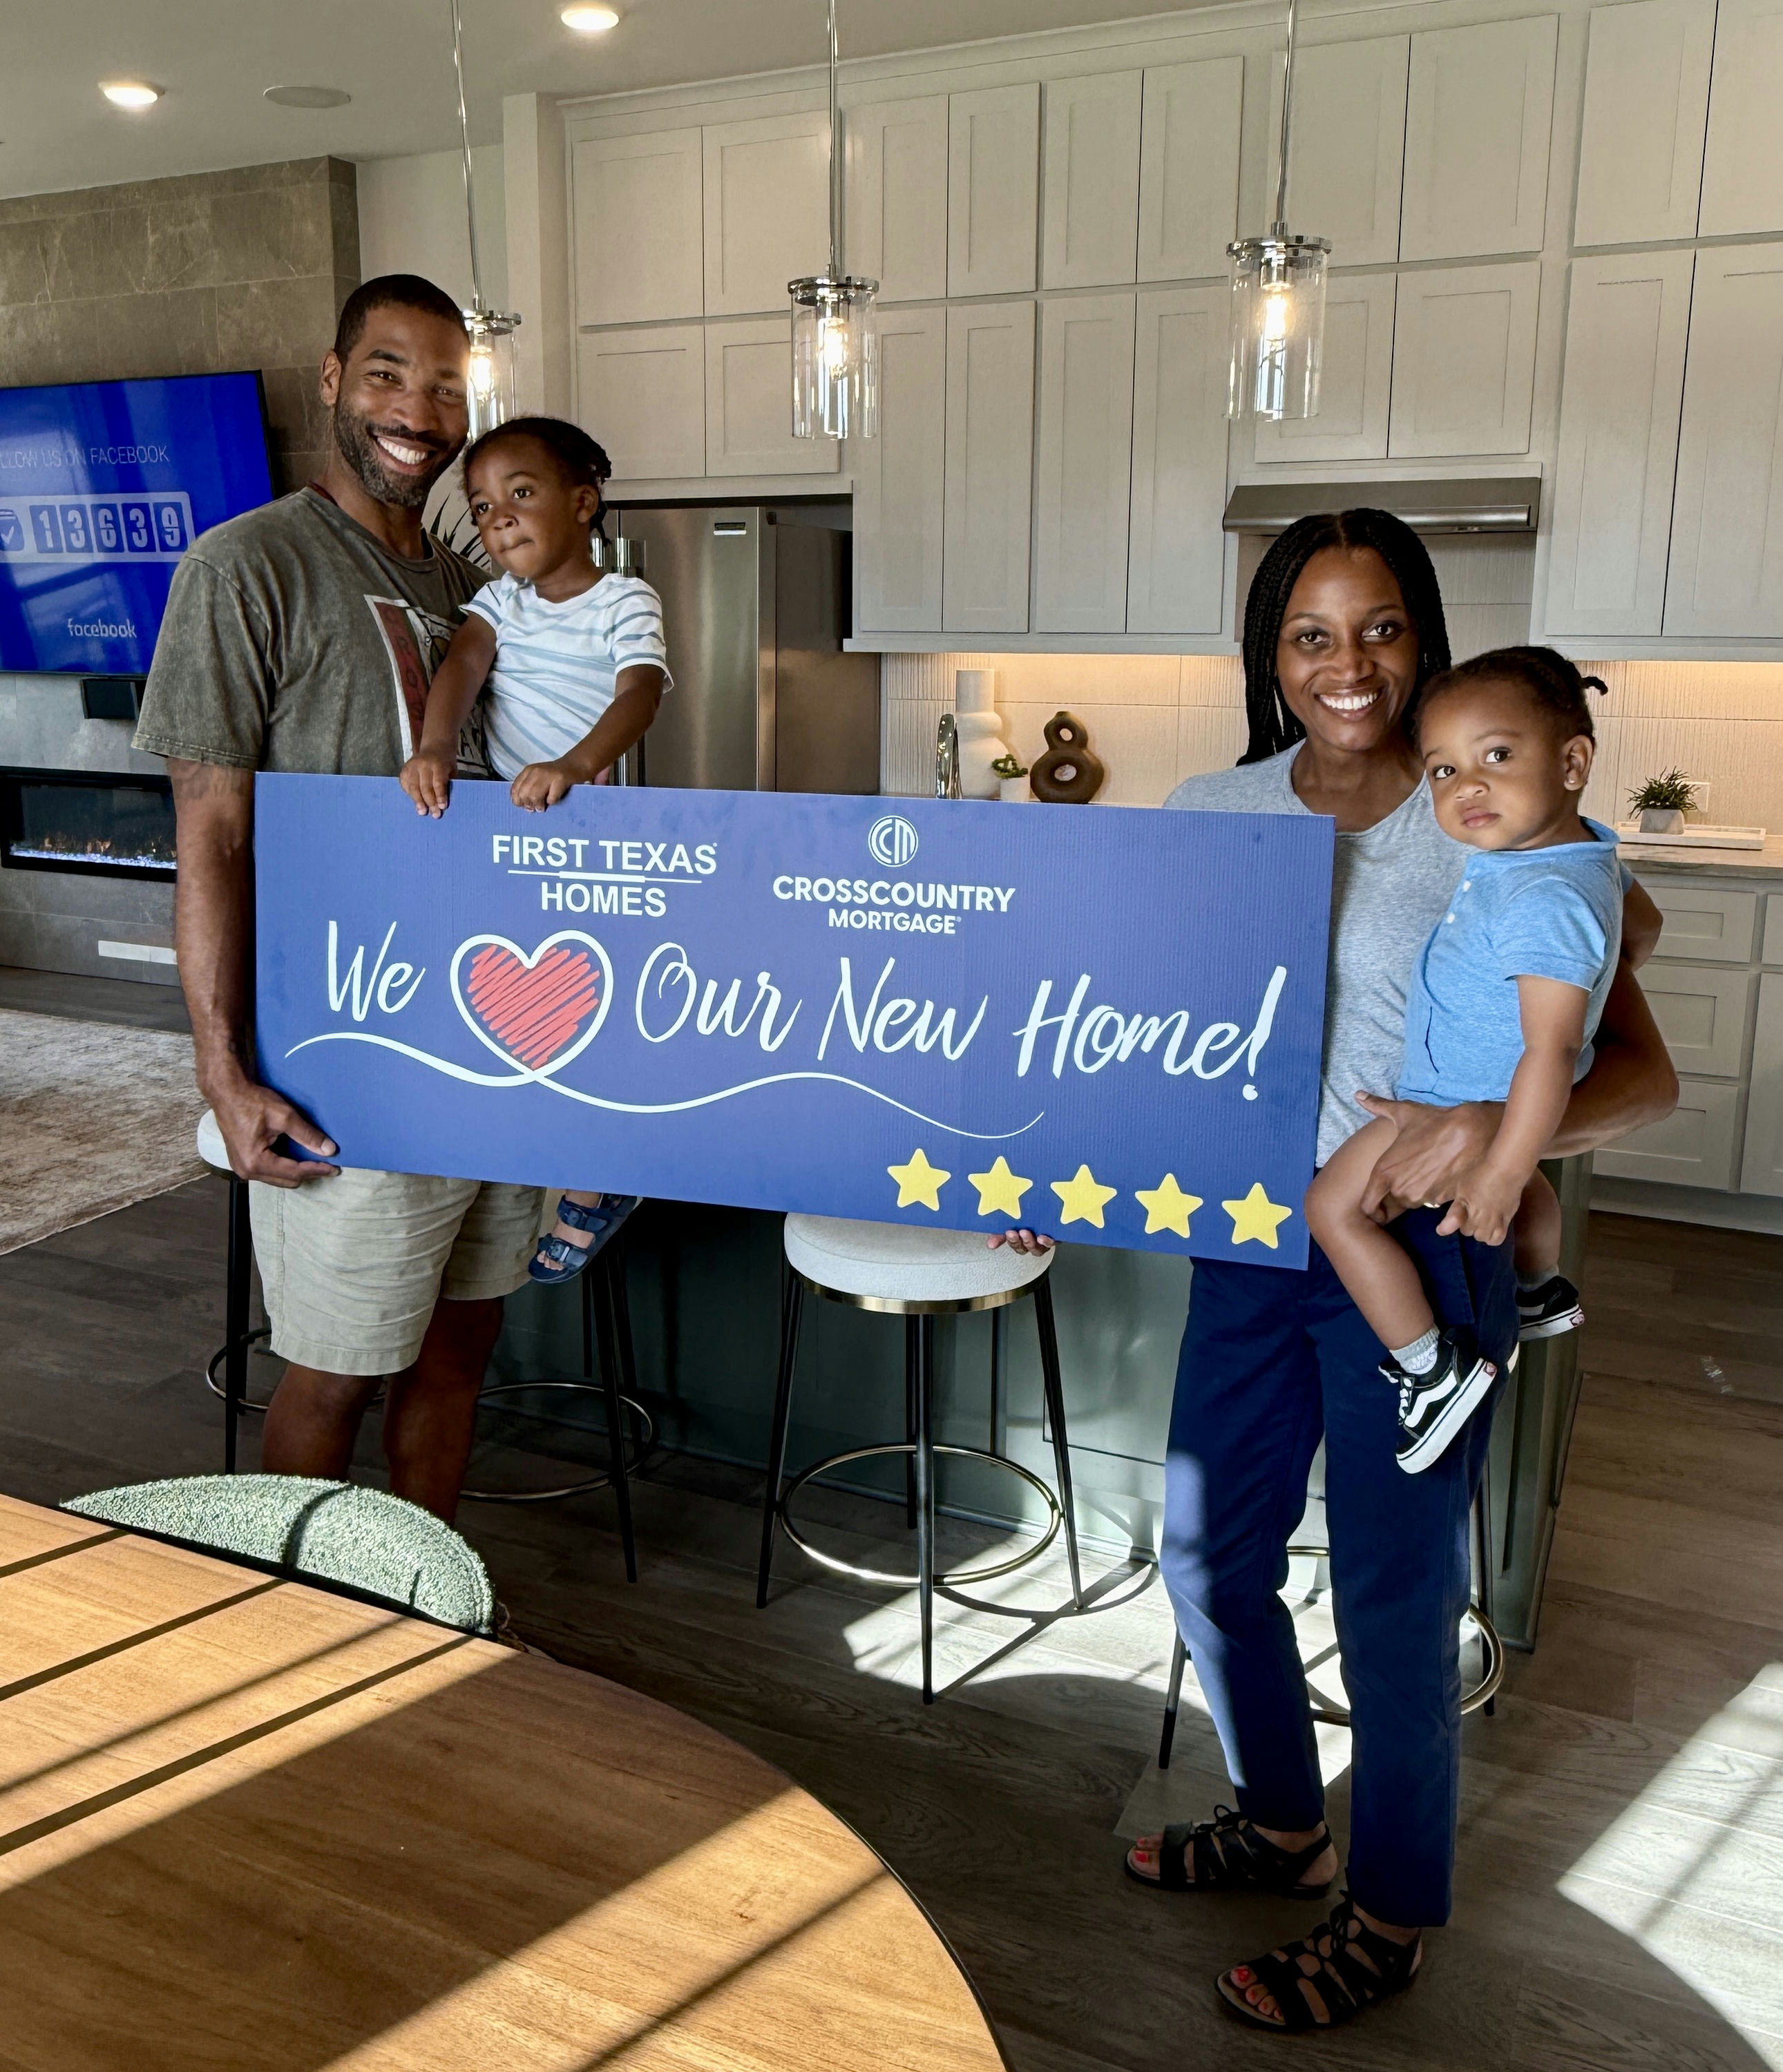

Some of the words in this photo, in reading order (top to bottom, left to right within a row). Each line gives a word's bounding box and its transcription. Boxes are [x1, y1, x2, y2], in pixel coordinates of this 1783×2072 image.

[41, 447, 61, 467] US
[65, 447, 87, 466] ON
[90, 445, 170, 465] FACEBOOK
[39, 506, 182, 548] 13639
[68, 618, 137, 638] facebook
[493, 834, 589, 868] FIRST
[598, 840, 717, 875] TEXAS
[541, 881, 667, 917] HOMES
[772, 875, 1016, 913] CROSSCOUNTRY
[828, 908, 957, 934] MORTGAGE
[327, 920, 426, 1022] We
[635, 941, 803, 1052] Our
[817, 957, 989, 1061] New
[1011, 965, 1288, 1101] Home!
